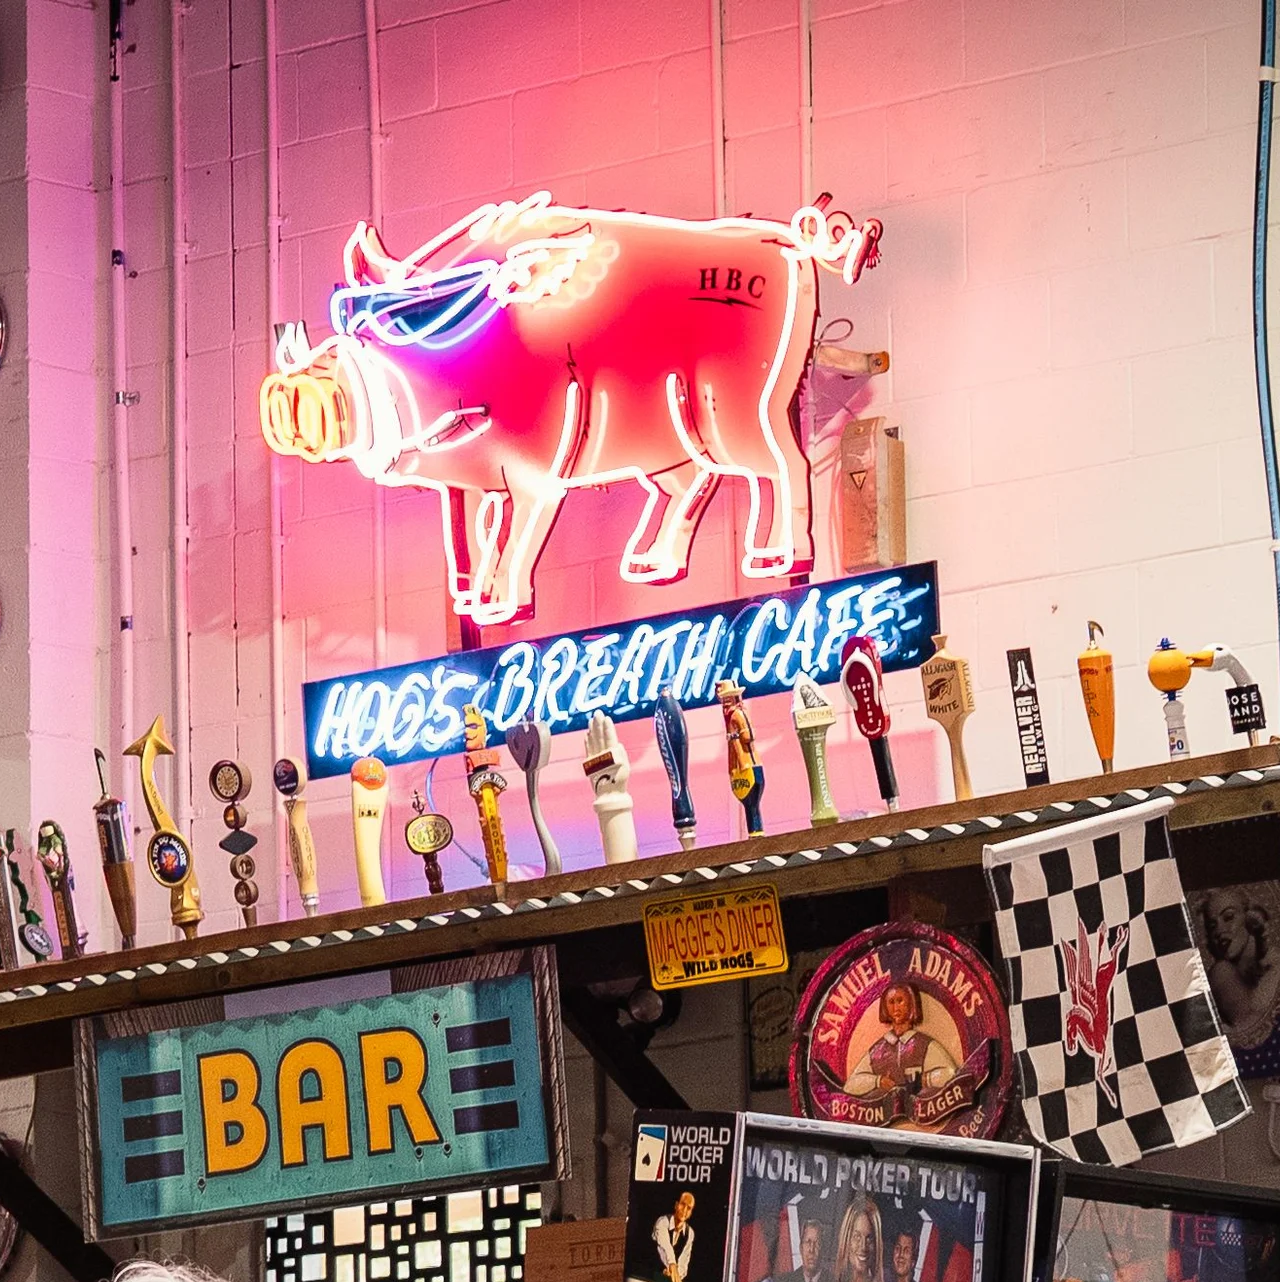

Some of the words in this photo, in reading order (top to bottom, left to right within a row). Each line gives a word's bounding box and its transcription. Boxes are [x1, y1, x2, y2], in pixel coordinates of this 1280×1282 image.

[492, 614, 723, 734] BREATH
[741, 577, 904, 689] CAFE
[922, 660, 957, 676] ALLAGASH
[929, 700, 960, 714] WHITE
[1016, 695, 1042, 775] REVOLVER
[650, 910, 727, 964] MAGGIE'S
[727, 903, 779, 952] DINER
[682, 959, 719, 978] WILD
[720, 951, 755, 969] HOGS
[816, 951, 892, 1046] SAMUEL
[908, 947, 984, 1017] ADAMS
[197, 1026, 444, 1178] BAR
[831, 1100, 885, 1123] BOSTON
[917, 1085, 965, 1118] LAGER
[671, 1126, 731, 1146] WORLD
[958, 1104, 987, 1139] Beer
[670, 1145, 724, 1165] POKER
[668, 1164, 712, 1184] TOUR
[745, 1144, 830, 1190] WORLD
[835, 1155, 911, 1198] POKER
[918, 1166, 977, 1205] TOUR
